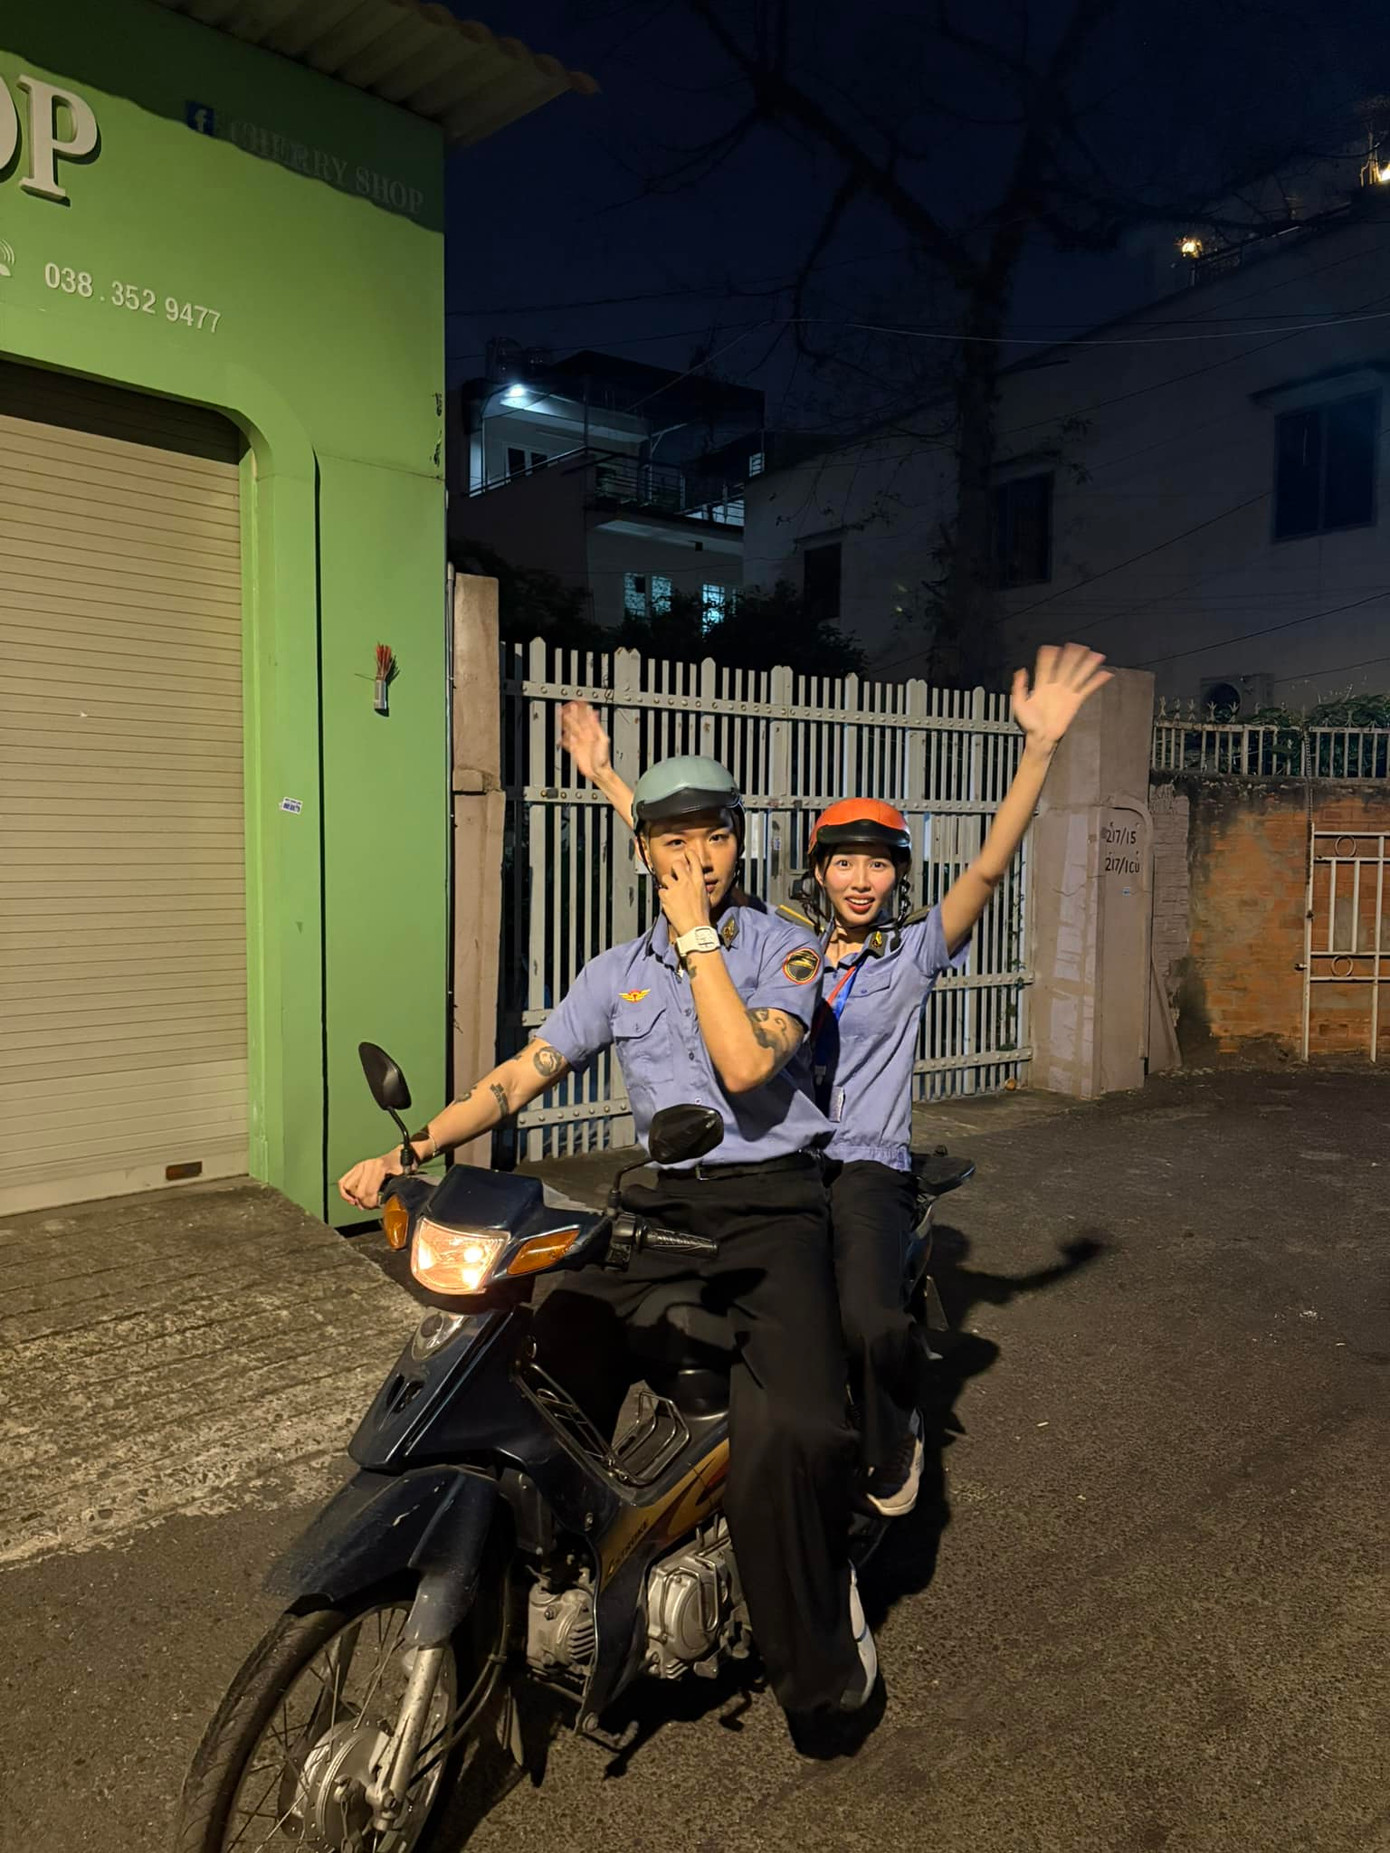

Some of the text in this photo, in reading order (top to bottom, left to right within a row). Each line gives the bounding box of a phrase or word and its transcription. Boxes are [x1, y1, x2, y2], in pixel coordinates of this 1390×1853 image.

[0, 74, 99, 198] P
[230, 119, 349, 187] CHERRY
[355, 166, 424, 214] SHOP
[45, 262, 94, 298] 038
[111, 280, 156, 315] 352
[165, 297, 221, 333] 9477
[1105, 827, 1137, 845] 217/15
